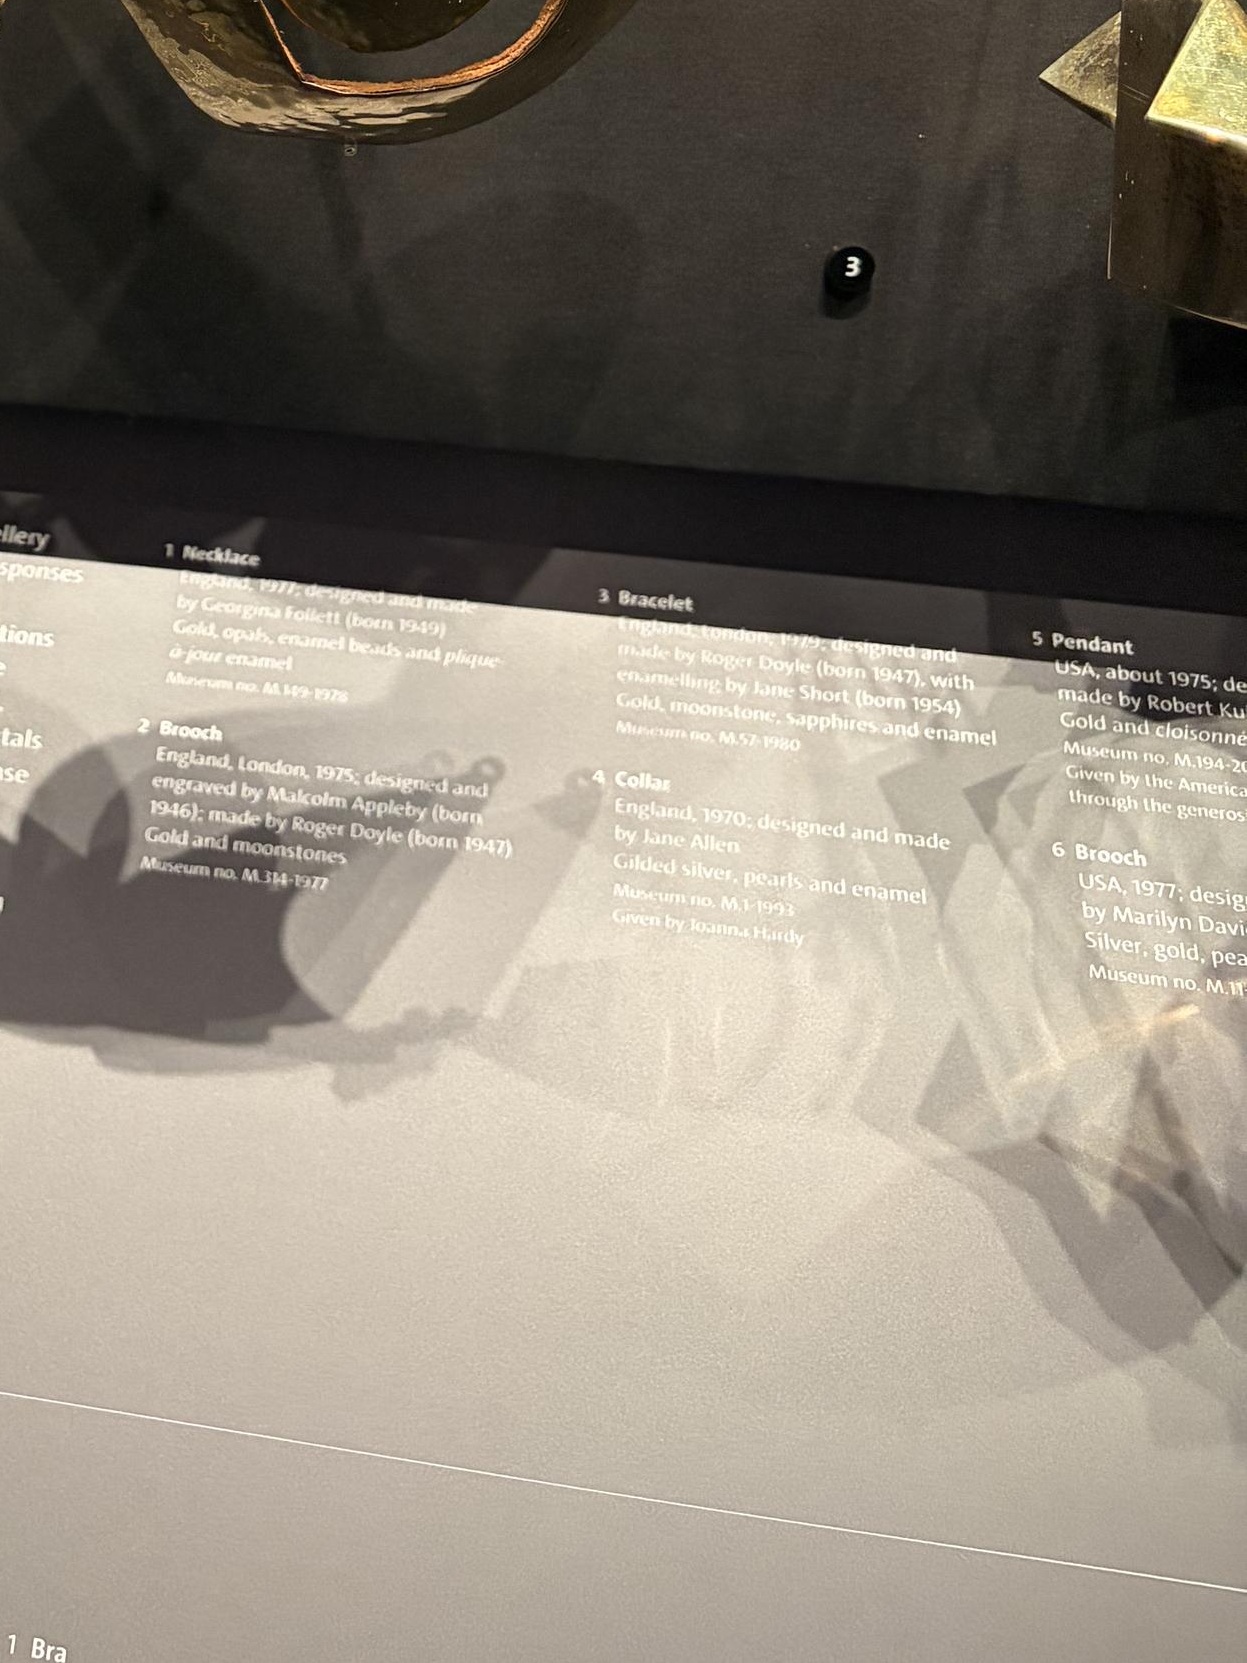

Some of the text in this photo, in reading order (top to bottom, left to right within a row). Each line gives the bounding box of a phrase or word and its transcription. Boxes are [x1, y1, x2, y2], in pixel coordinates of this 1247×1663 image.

[844, 256, 861, 278] 3
[165, 543, 260, 566] 1 Necklace
[1032, 631, 1134, 655] 5 Pendant
[1054, 660, 1100, 680] USA,
[1105, 664, 1163, 685] about
[1168, 671, 1218, 692] 1975;
[1058, 688, 1113, 705] made
[1118, 690, 1141, 712] by
[1147, 694, 1213, 716] Robert
[137, 717, 223, 741] 2 Brooch
[1060, 711, 1247, 746] Gold and cloisonné
[155, 745, 489, 798] England, London, 1975; designed and
[1065, 764, 1115, 783] Given
[1119, 769, 1140, 790] by
[1144, 773, 1173, 790] the
[151, 776, 483, 824] engraved by Malcolm Appleby (born
[144, 826, 347, 864] Gold and moonstones
[1051, 841, 1147, 867] 6 Brooch
[139, 855, 210, 877] Museum
[213, 867, 238, 880] no.
[1078, 872, 1247, 912] USA, 1977; desig
[1081, 900, 1247, 936] by Marilyn Davi
[1084, 931, 1148, 957] Silver,
[1153, 942, 1205, 964] gold,
[8, 1634, 67, 1663] 1 Bra
